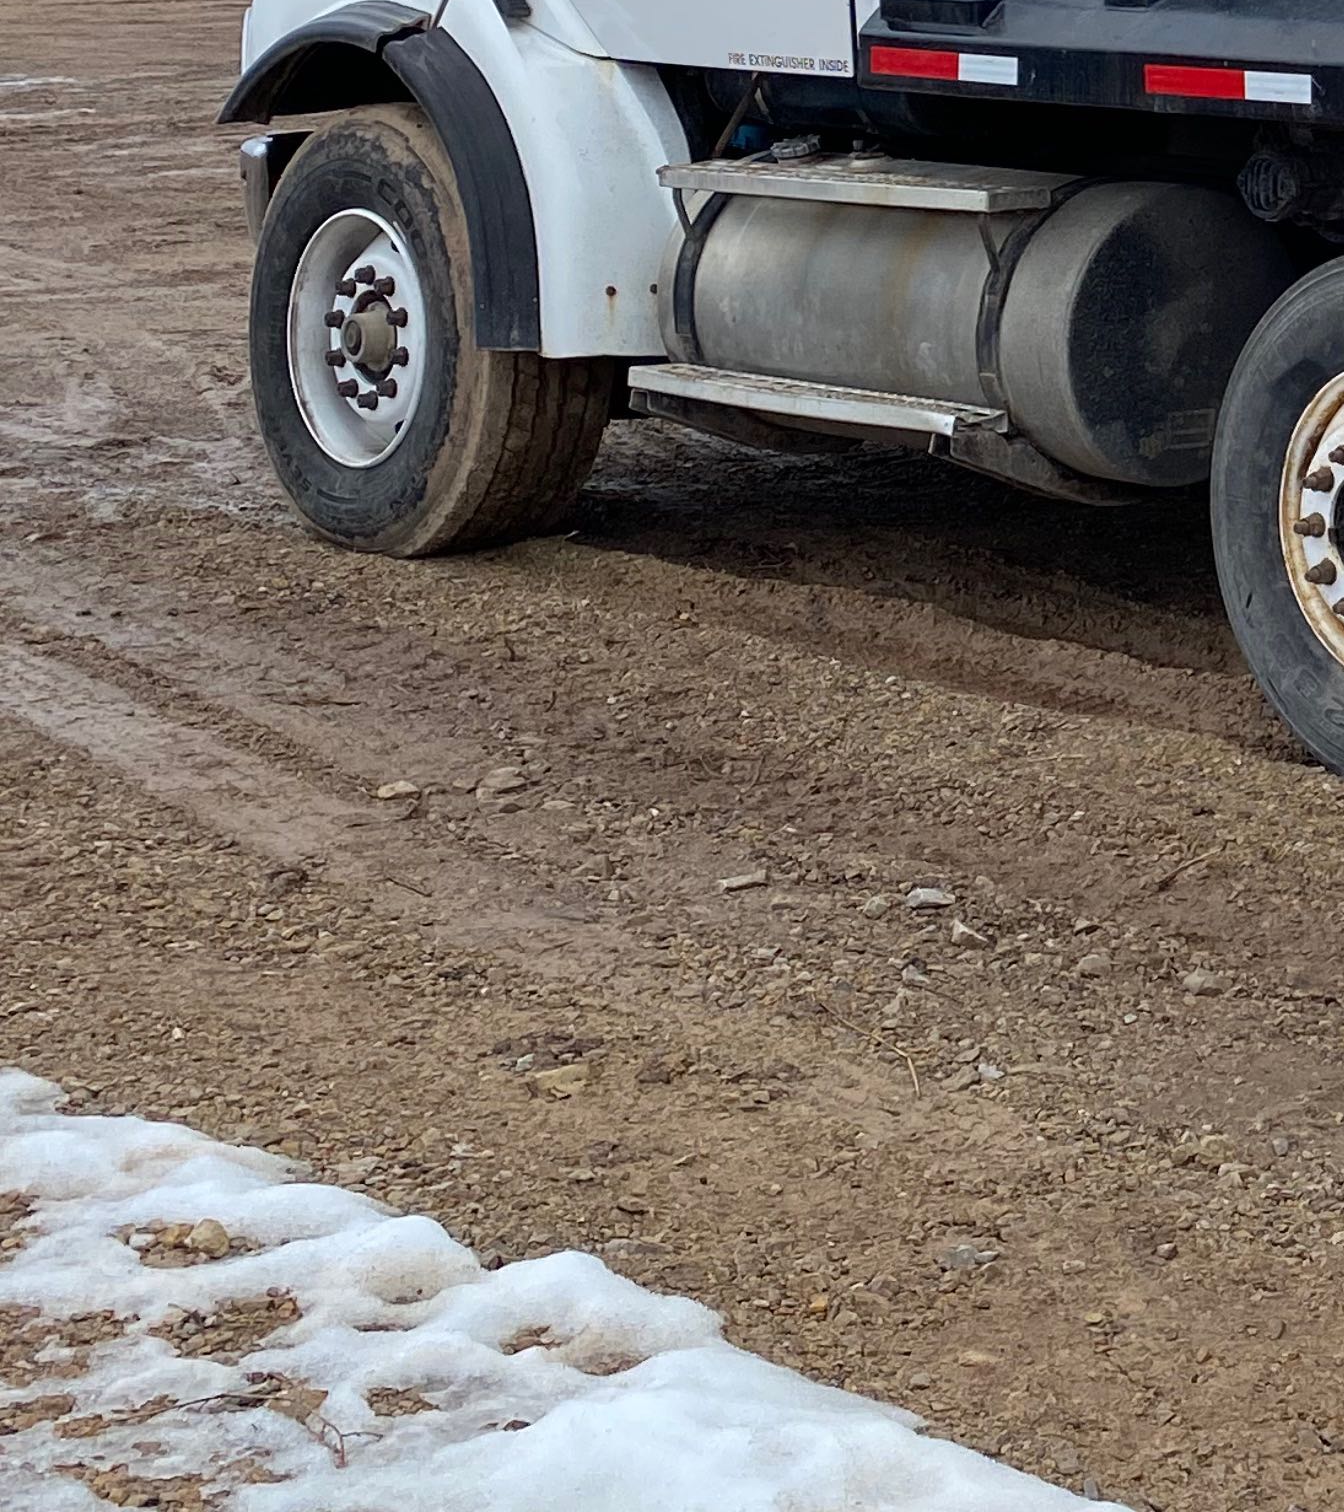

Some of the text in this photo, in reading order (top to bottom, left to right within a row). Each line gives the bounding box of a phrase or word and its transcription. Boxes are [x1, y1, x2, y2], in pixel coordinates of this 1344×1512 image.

[728, 53, 849, 72] FIRE EXTINGUISHER INSIDE
